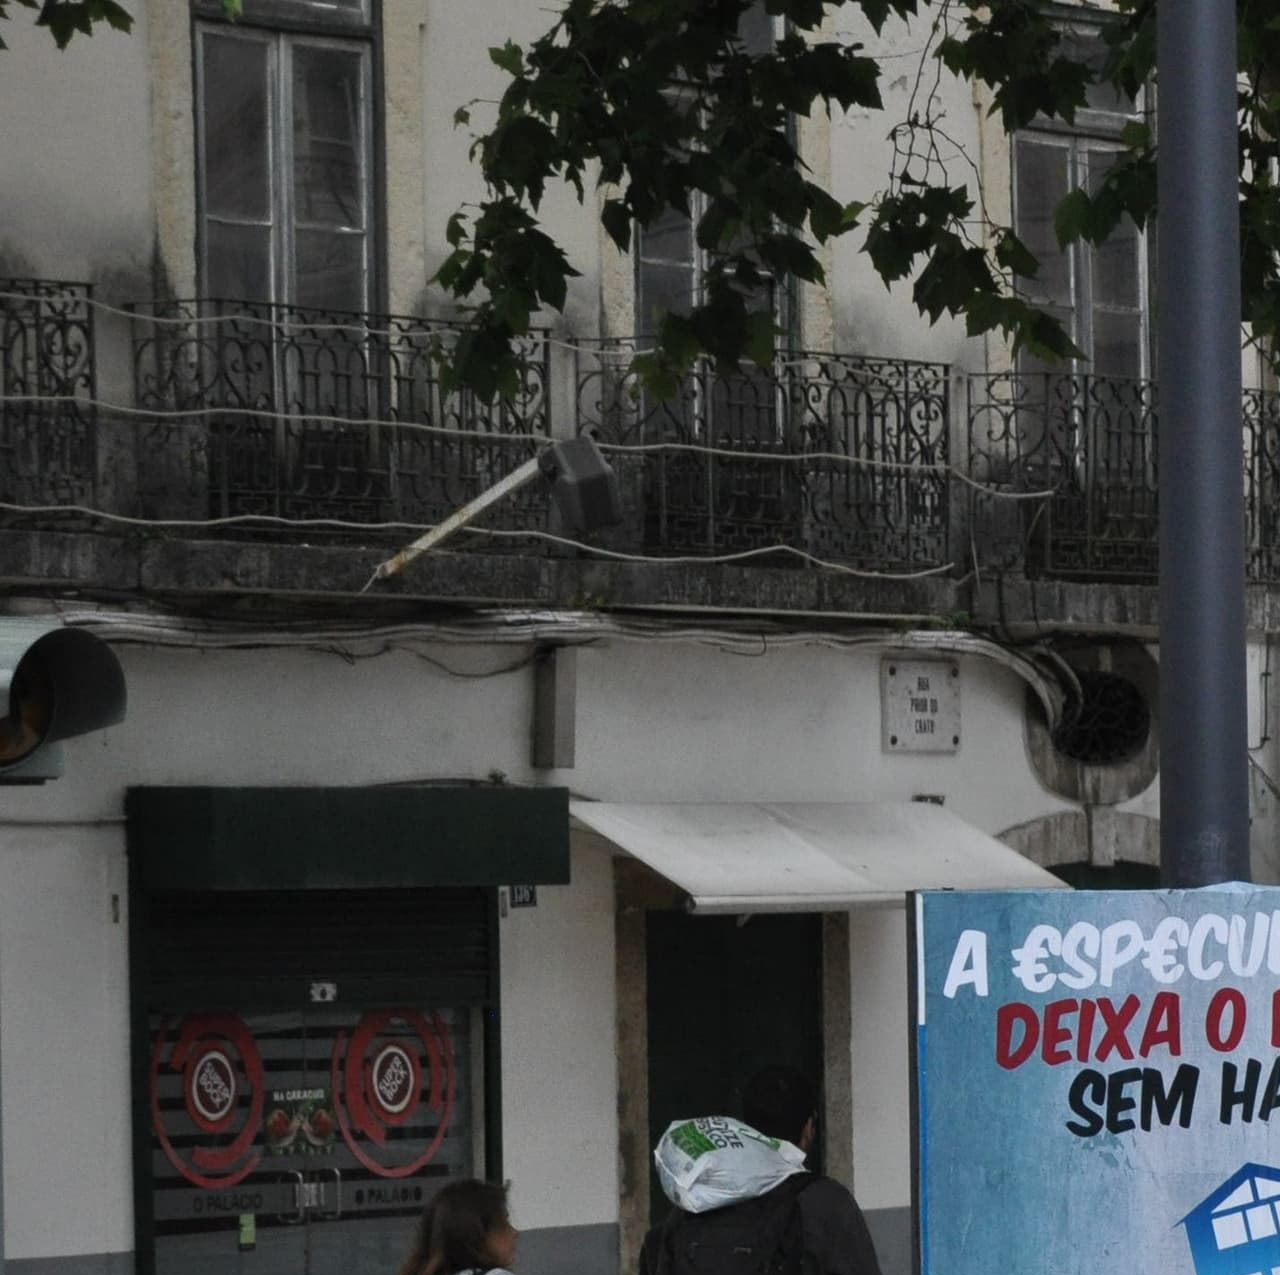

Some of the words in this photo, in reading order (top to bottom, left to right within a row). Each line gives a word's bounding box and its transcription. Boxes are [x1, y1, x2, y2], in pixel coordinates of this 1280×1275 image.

[943, 929, 989, 999] A
[995, 991, 1181, 1070] DEIXA
[1205, 987, 1247, 1053] O
[1066, 1063, 1200, 1138] SEM
